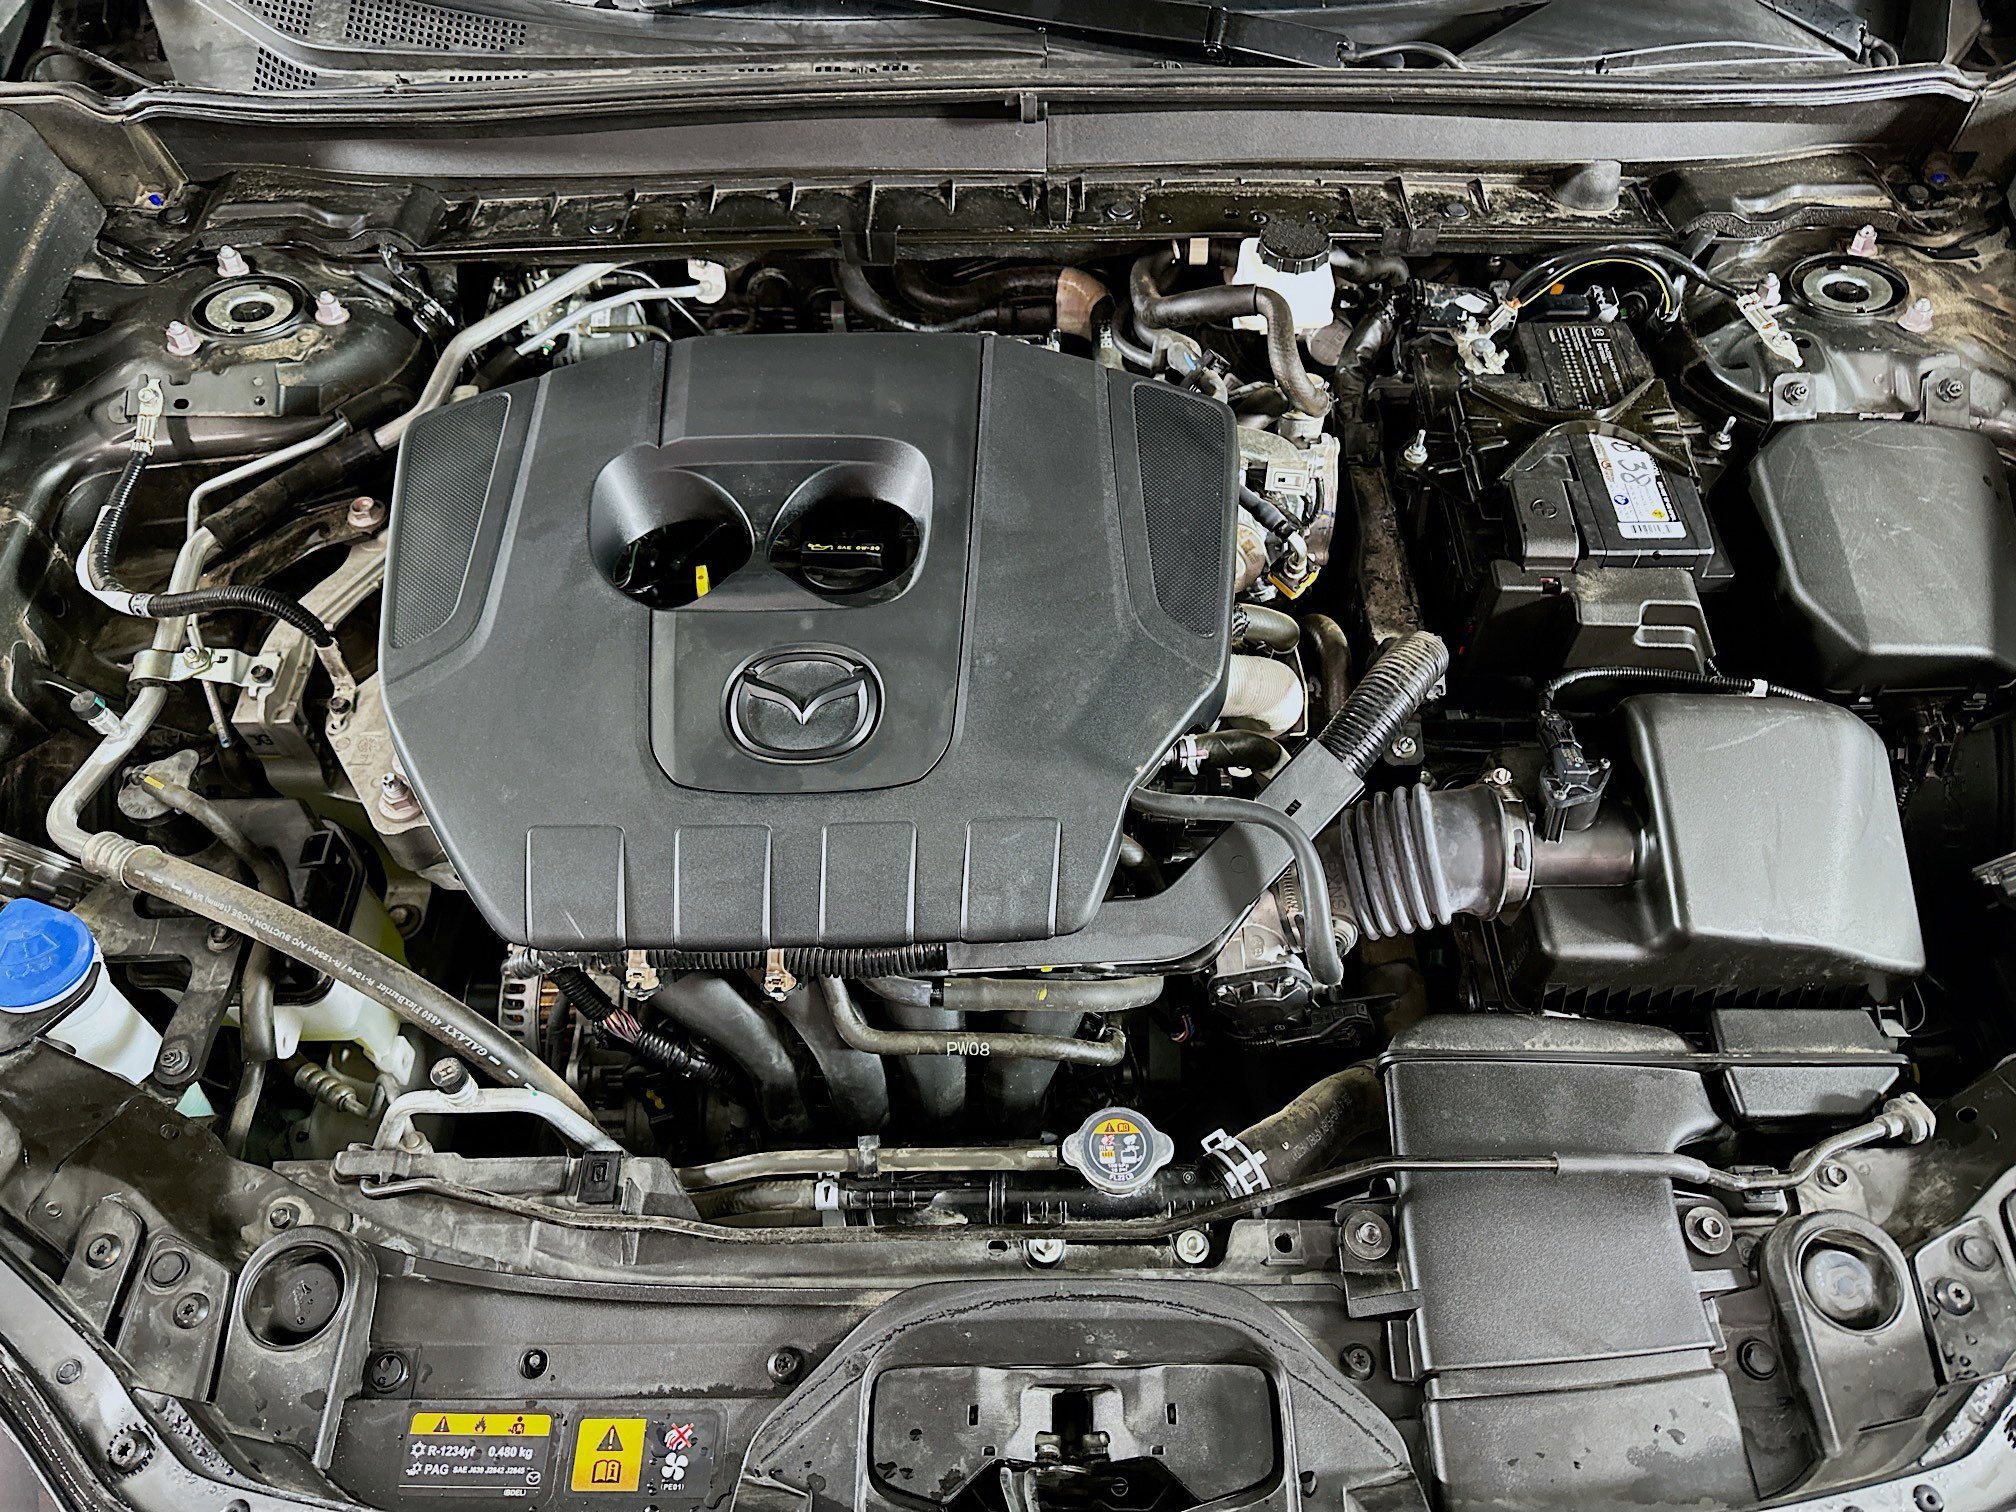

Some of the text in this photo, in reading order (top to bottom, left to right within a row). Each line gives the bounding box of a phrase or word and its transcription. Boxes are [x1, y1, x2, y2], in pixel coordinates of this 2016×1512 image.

[231, 908, 255, 924] HOSE
[255, 920, 291, 941] SUCTION
[292, 936, 307, 950] A/C
[305, 944, 341, 968] R-1234yf
[347, 966, 375, 987] R-134a
[376, 984, 423, 1015] FlexBarrier
[421, 1010, 442, 1026] 4880
[440, 1024, 488, 1056] GALAXY
[946, 1041, 990, 1057] PW08
[427, 1445, 534, 1460] R-1234yf 0.480 kg
[424, 1463, 449, 1475] PAG
[453, 1466, 468, 1474] SAE
[468, 1466, 485, 1474] J639
[485, 1466, 504, 1474] J2842
[660, 1483, 685, 1491] (PE01)
